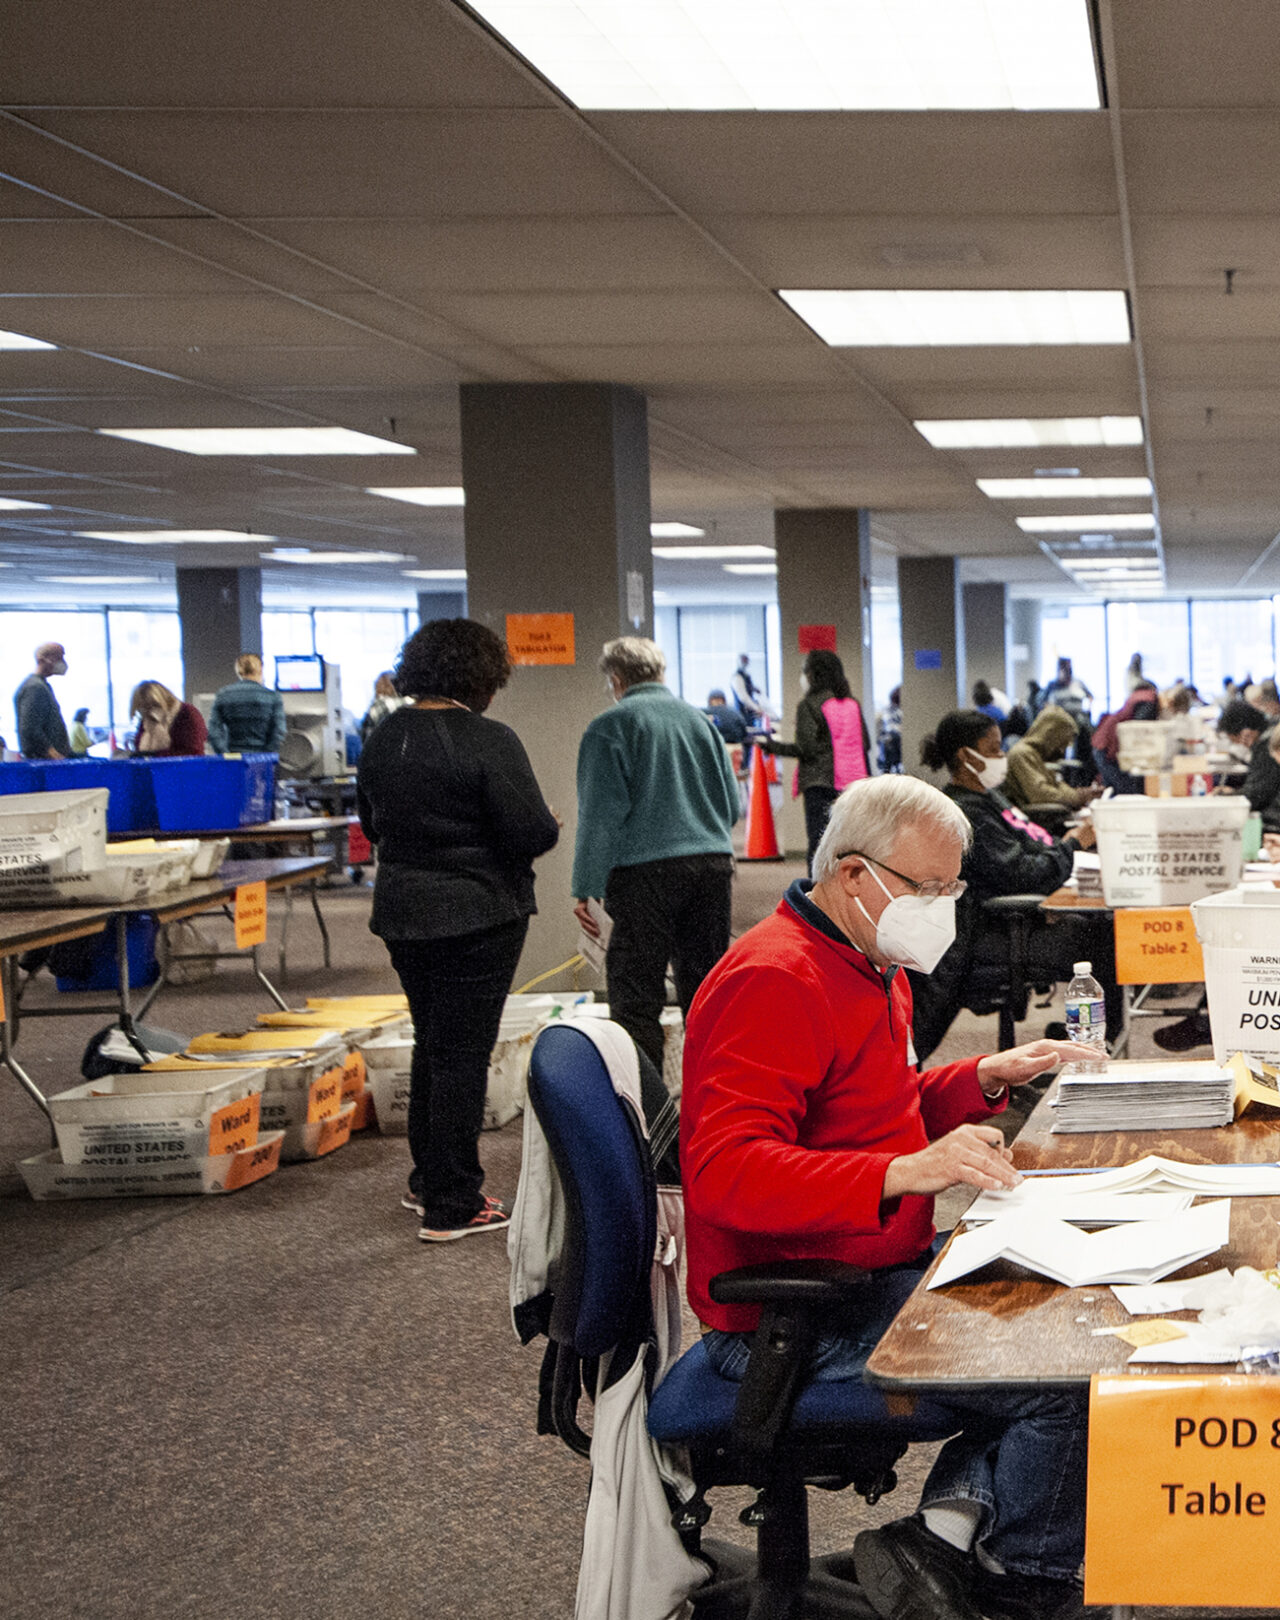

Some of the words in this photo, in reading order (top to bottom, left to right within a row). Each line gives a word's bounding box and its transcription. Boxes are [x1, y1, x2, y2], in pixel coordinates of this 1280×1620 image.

[1123, 852, 1170, 863] UNITED
[1172, 852, 1221, 863] STATES
[1118, 866, 1168, 877] POSTAL
[1172, 865, 1226, 877] SERVICE
[1143, 921, 1173, 934] POD
[1176, 920, 1185, 933] 8
[1140, 942, 1177, 955] Table
[1180, 941, 1188, 954] 2
[343, 1064, 358, 1081] ard
[260, 1105, 286, 1117] TES
[221, 1107, 251, 1133] Ward
[84, 1144, 132, 1156] UNITED
[135, 1140, 185, 1154] STATES
[1175, 1418, 1257, 1448] POD
[1161, 1482, 1266, 1516] Table
